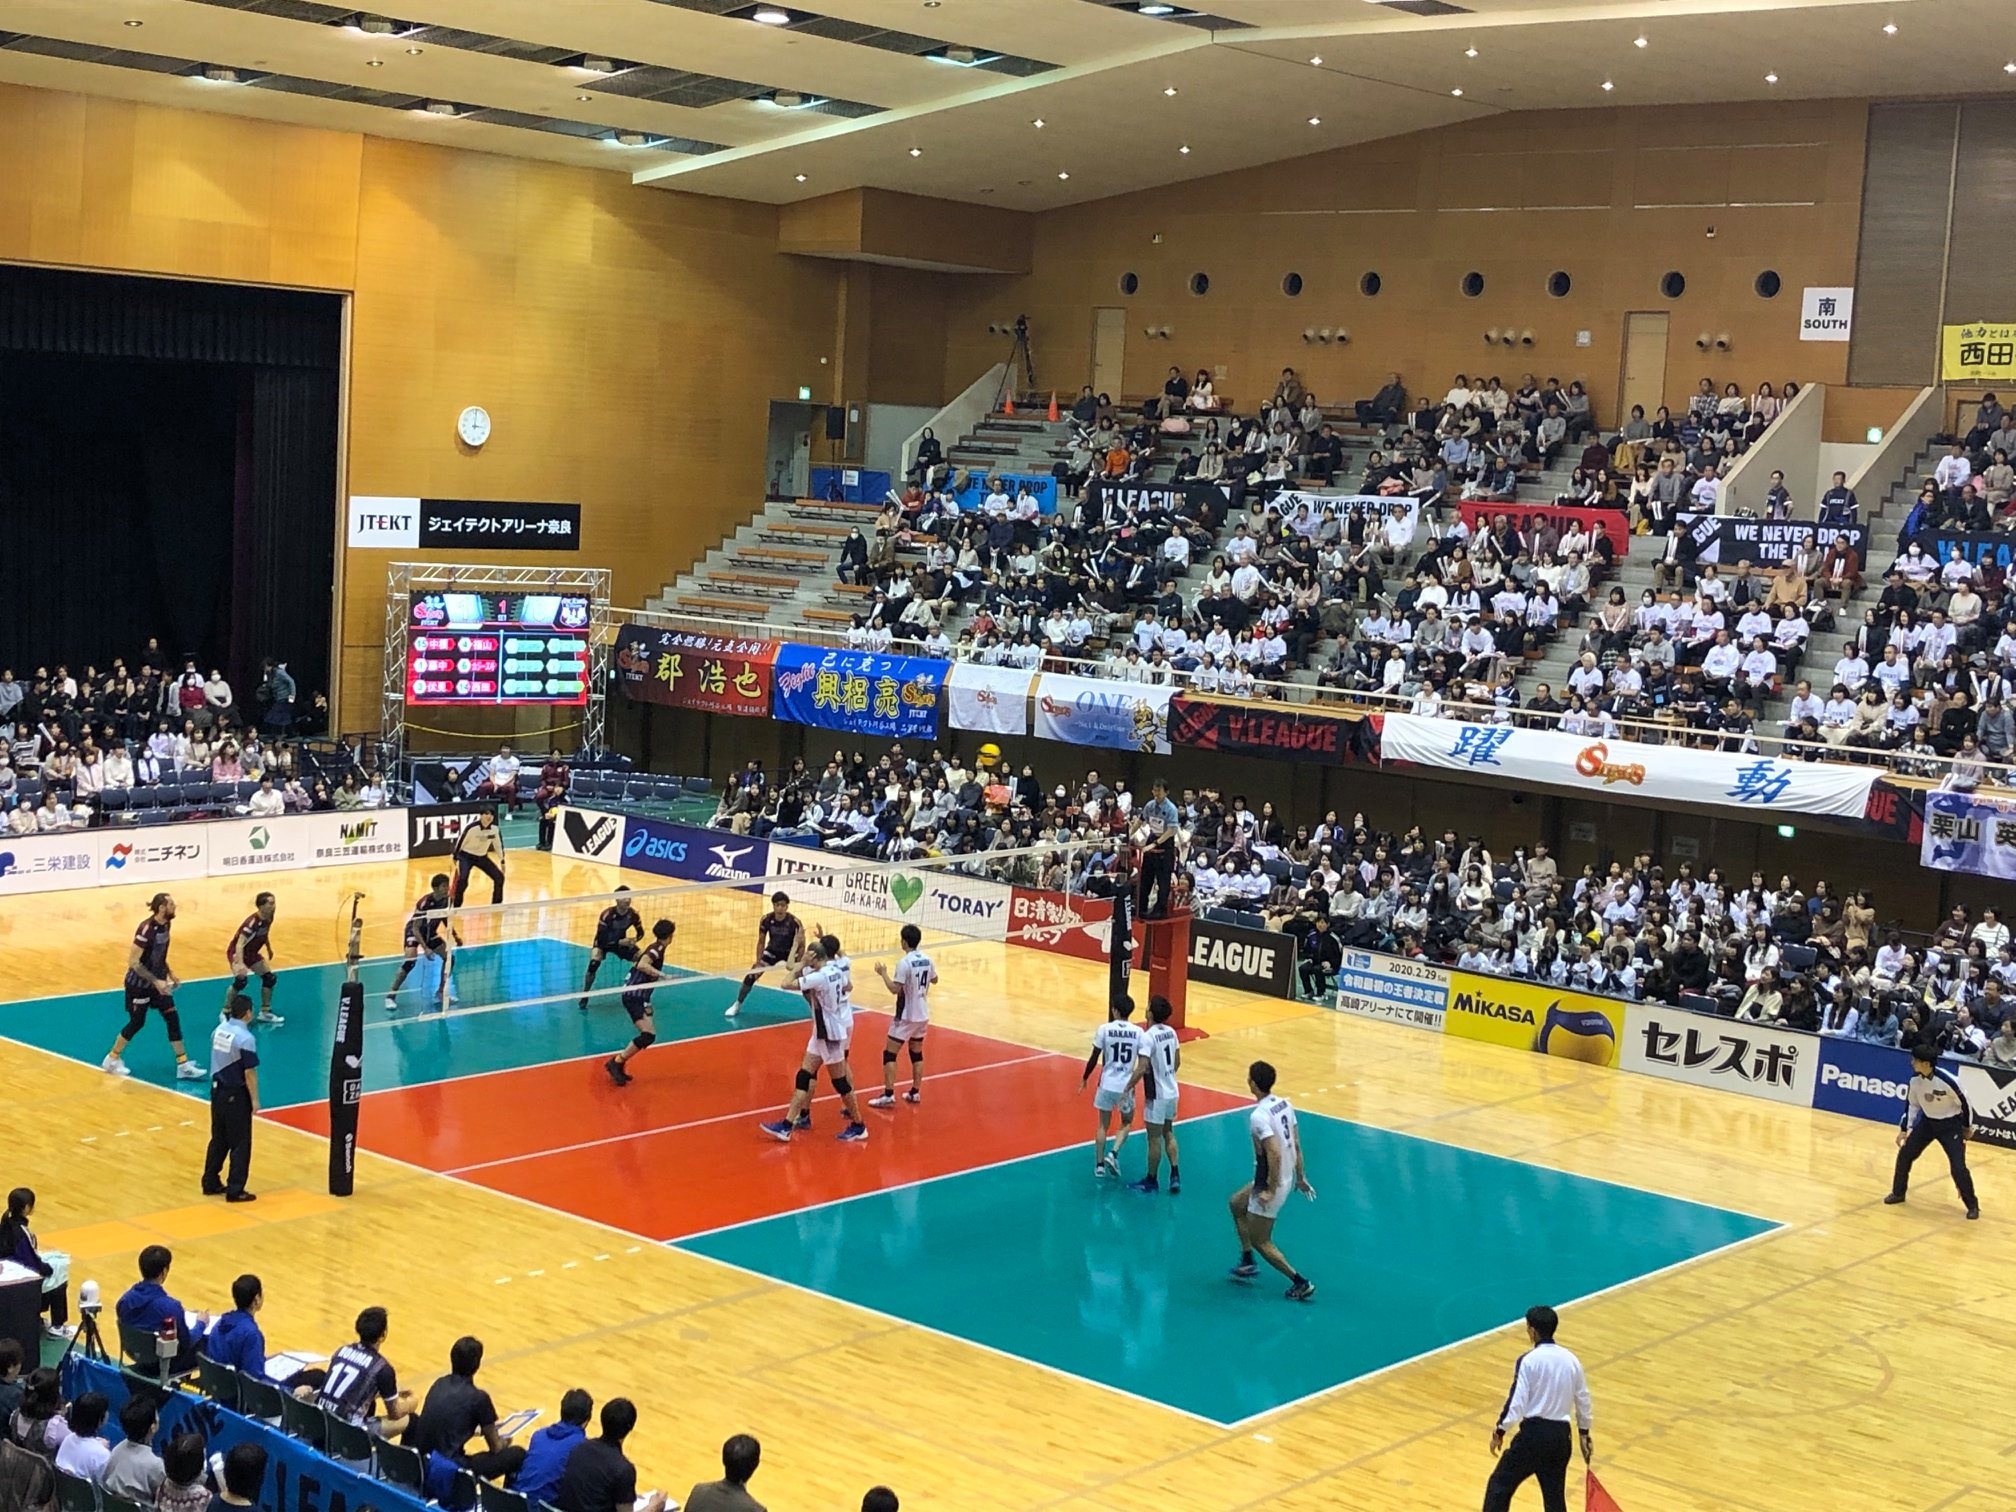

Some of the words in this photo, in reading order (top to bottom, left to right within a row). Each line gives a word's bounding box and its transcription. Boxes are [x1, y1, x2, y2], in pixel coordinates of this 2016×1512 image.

[1818, 297, 1836, 316] 南
[1803, 319, 1848, 330] SOUTH
[1960, 342, 2014, 366] 西田
[357, 514, 412, 534] JTEKT
[428, 516, 572, 535] ジェイテクトアリーナ奈良
[1692, 516, 1722, 546] GUE
[1735, 524, 1758, 541] WE
[1758, 543, 1788, 560] THE
[499, 600, 507, 614] 1
[1076, 690, 1134, 717] ONE
[1725, 758, 1792, 803] 動
[581, 817, 618, 855] LEAGUE
[1929, 811, 1981, 843] 栗山
[147, 845, 201, 863] ニチネン
[645, 837, 689, 862] asics
[33, 854, 91, 873] 三栄建設
[845, 871, 889, 895] GREEN
[915, 970, 929, 990] 14
[1389, 962, 1437, 980] 2020.2.29
[336, 996, 352, 1044] V.LEAGUE
[1340, 995, 1443, 1027] 高崎アリーナにて開催!!
[1453, 990, 1536, 1026] MIKASA
[1110, 1041, 1133, 1064] 15
[1163, 1043, 1172, 1066] 1
[1641, 1020, 1800, 1091] セレスポ
[1821, 1063, 1909, 1101] Panaso
[1990, 1091, 2016, 1120] LEA
[1281, 1114, 1291, 1140] 3
[323, 1362, 360, 1399] 17
